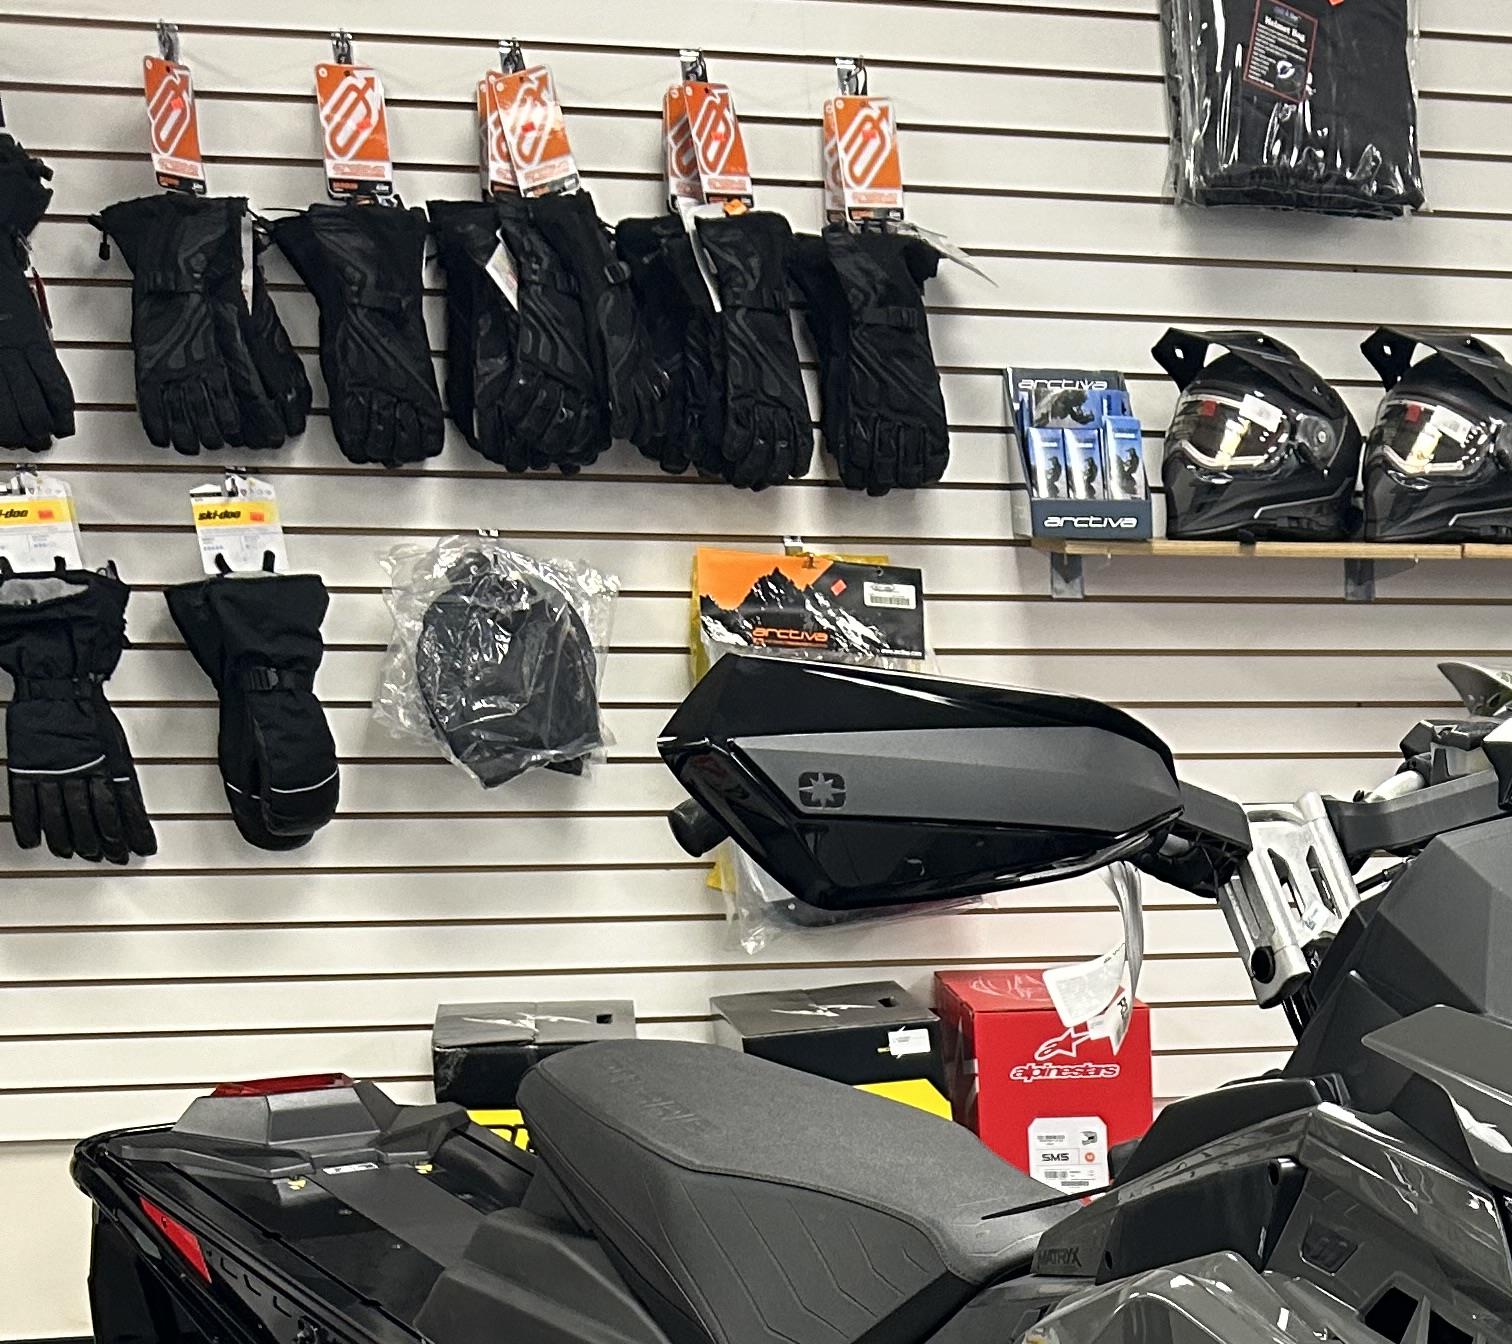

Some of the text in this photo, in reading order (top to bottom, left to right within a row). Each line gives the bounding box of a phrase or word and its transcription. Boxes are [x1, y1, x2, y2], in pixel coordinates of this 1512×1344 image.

[1018, 378, 1108, 390] arctiva
[0, 508, 29, 519] -doo
[198, 509, 241, 520] ski-doo
[1043, 515, 1138, 528] arctiva
[752, 627, 829, 642] arctiva
[1010, 1062, 1120, 1082] alpinestars
